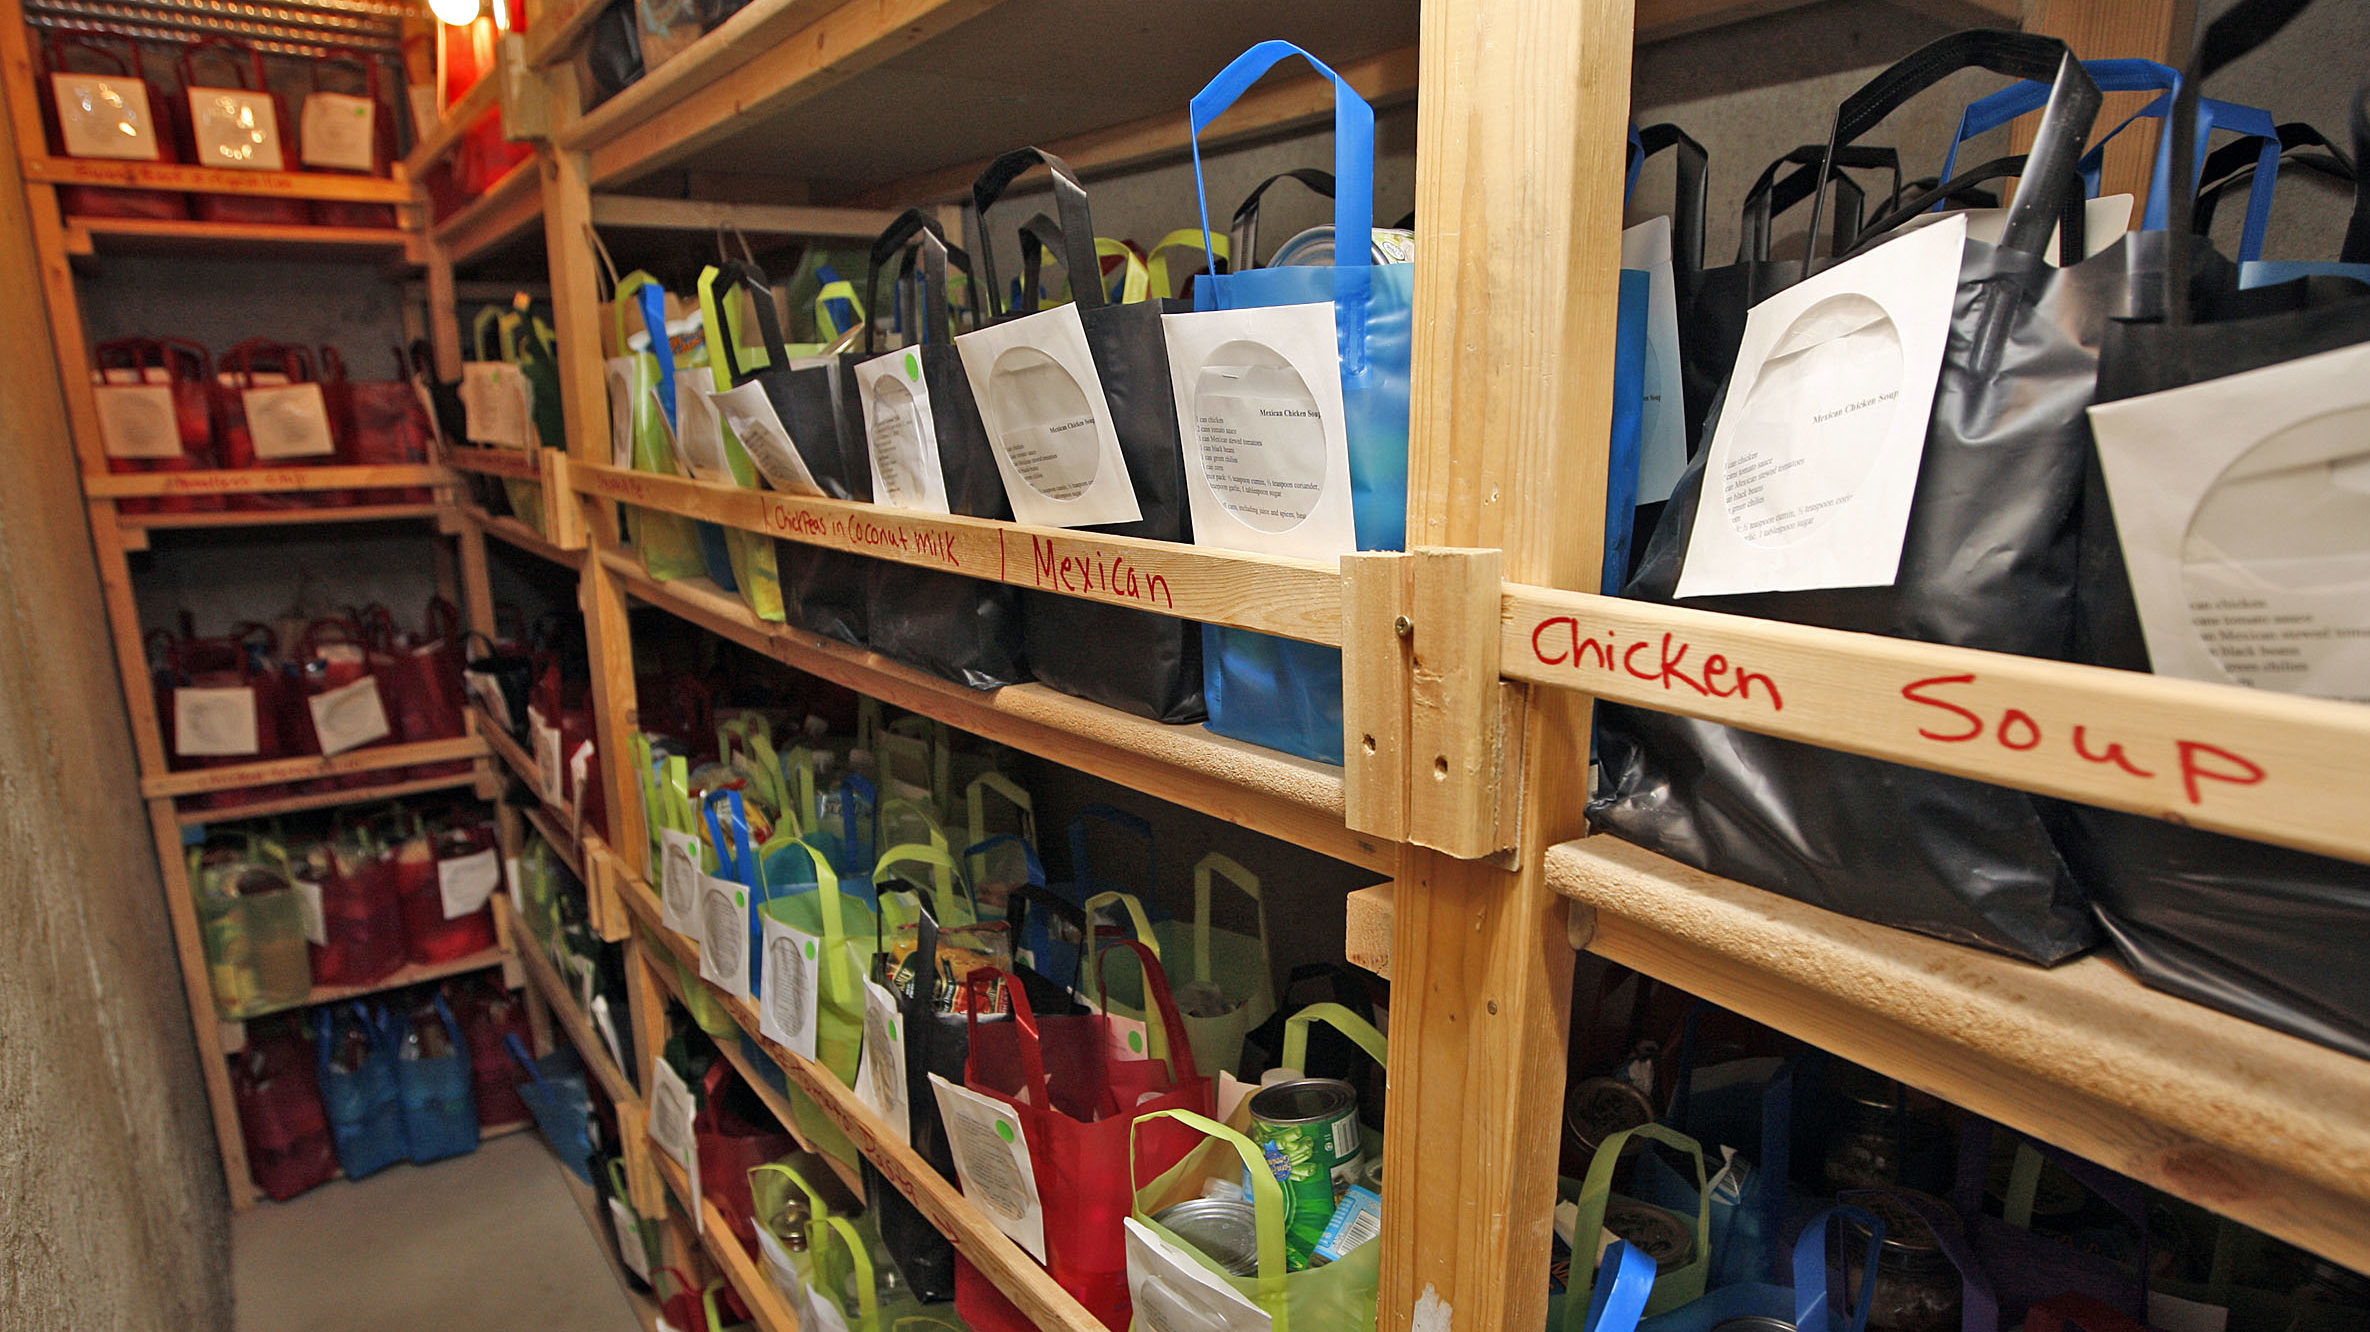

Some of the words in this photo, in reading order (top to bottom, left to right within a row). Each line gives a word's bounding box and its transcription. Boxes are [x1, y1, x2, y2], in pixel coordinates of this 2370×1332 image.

[1260, 409, 1283, 417] Mexican
[1284, 409, 1306, 418] Chicken
[1812, 409, 1843, 424] Mexican
[1844, 397, 1877, 414] Chicken
[1877, 389, 1900, 403] Soup
[1050, 425, 1067, 433] Mexican
[1067, 421, 1084, 430] Chicken
[1272, 480, 1293, 489] teaspoon
[832, 520, 845, 537] in
[848, 514, 908, 551] Coconut
[1032, 534, 1173, 610] Mexican
[1531, 615, 1784, 711] Chicken
